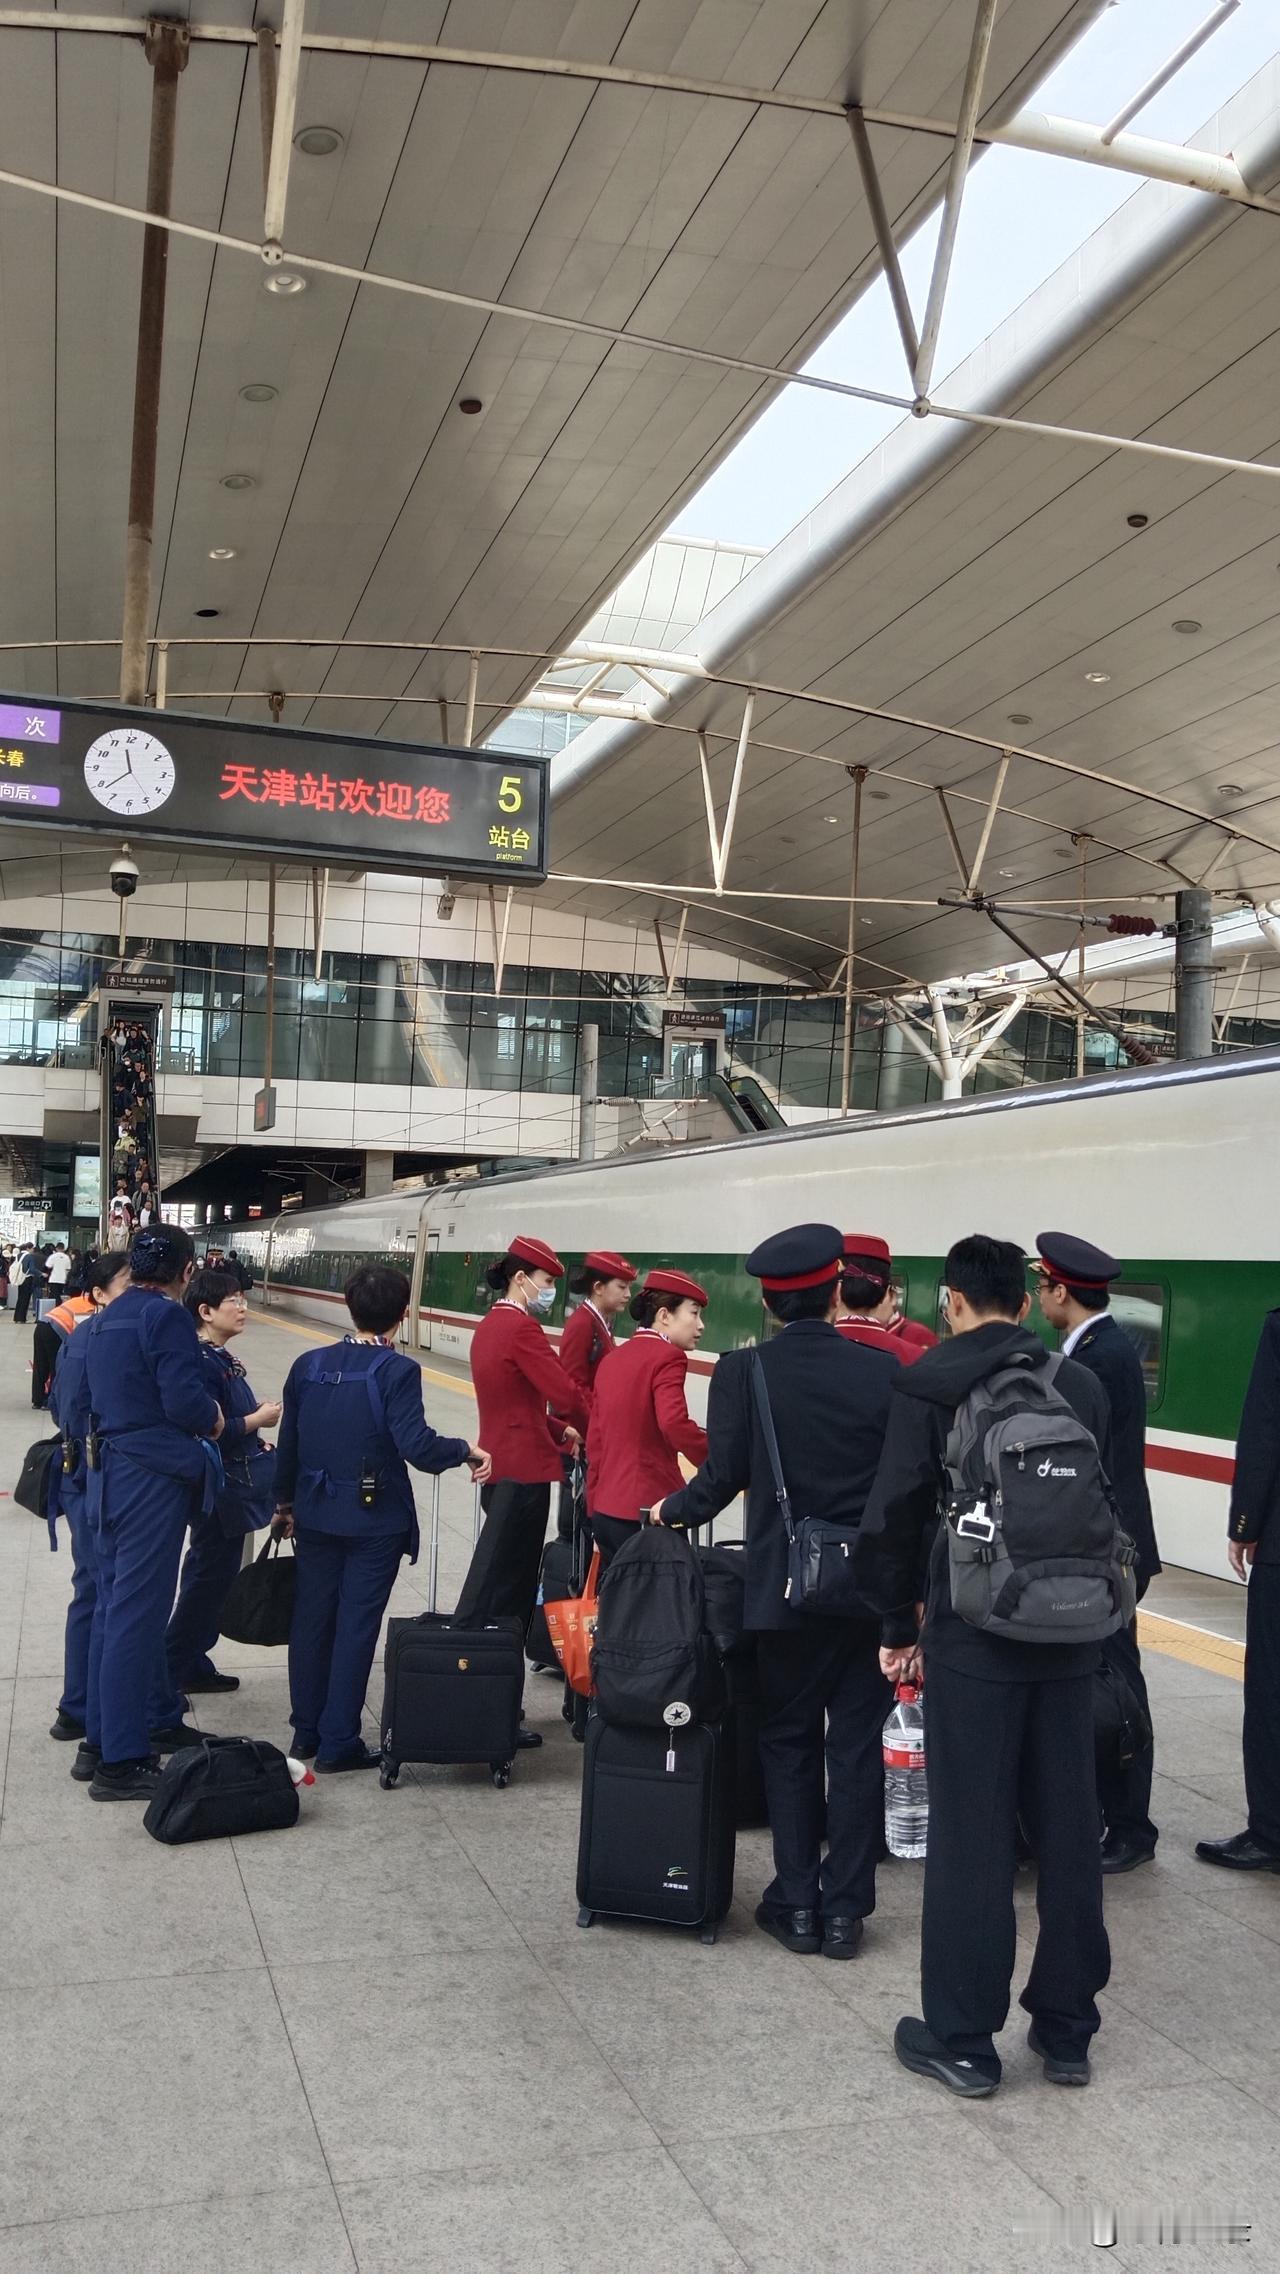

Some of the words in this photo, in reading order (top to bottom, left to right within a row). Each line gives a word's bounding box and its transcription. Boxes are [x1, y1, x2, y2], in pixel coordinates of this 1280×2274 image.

[24, 716, 46, 737] 次
[126, 736, 138, 744] 12
[219, 764, 451, 824] 天津站欢迎您
[498, 776, 522, 813] 5
[488, 825, 531, 850] 站台
[496, 852, 523, 862] platform
